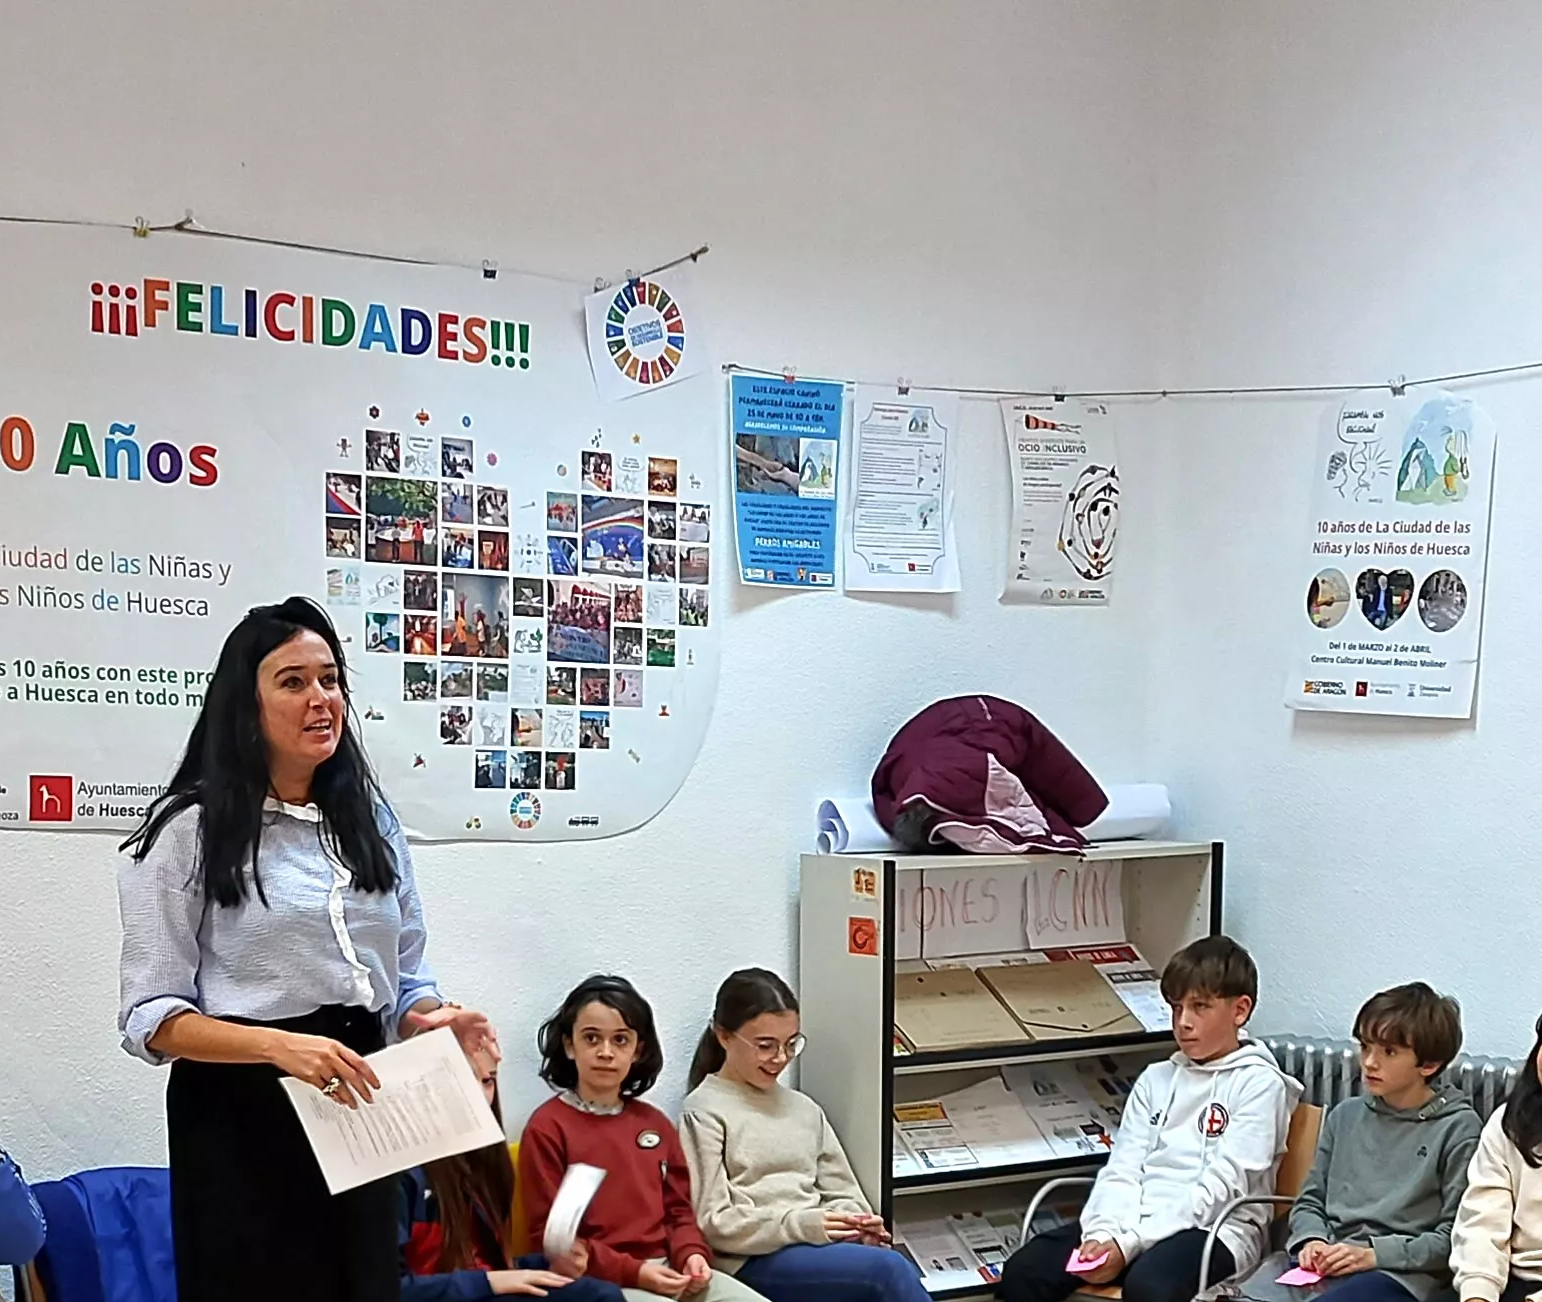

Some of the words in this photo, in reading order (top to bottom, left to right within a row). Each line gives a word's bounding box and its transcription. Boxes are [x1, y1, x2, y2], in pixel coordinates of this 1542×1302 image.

[90, 278, 531, 369] ¡¡¡FELICIDADES!!!
[54, 420, 219, 487] Años
[1018, 443, 1041, 453] OCIO
[1043, 444, 1087, 454] NCLUSIVO
[1317, 521, 1329, 534] 10
[1330, 520, 1356, 534] años
[1358, 521, 1373, 534] de
[1376, 521, 1390, 534] La
[1392, 520, 1433, 534] Ciudad
[1435, 520, 1451, 534] de
[1453, 520, 1471, 534] las
[1312, 542, 1342, 555] Niñas
[1344, 545, 1353, 558] y
[1354, 542, 1370, 555] los
[1373, 541, 1407, 555] Niños
[1410, 541, 1423, 556] de
[1426, 541, 1471, 556] Huesca
[75, 549, 104, 573] de
[110, 551, 142, 575] las
[148, 554, 213, 580] Niñas
[217, 562, 233, 586] y
[17, 584, 85, 611] Niños
[91, 587, 120, 611] de
[126, 591, 210, 617] Huesca
[1328, 642, 1341, 651] Del
[1347, 643, 1357, 651] de
[1358, 643, 1384, 652] MARZO
[1385, 644, 1393, 652] al
[1399, 645, 1409, 654] de
[1311, 654, 1334, 665] Centro
[1335, 656, 1364, 666] Cultural
[1365, 657, 1392, 667] Manuel
[1393, 658, 1418, 668] Benito
[12, 659, 36, 678] 10
[42, 658, 91, 680] años
[95, 664, 132, 682] con
[137, 665, 178, 685] este
[6, 686, 19, 701] a
[25, 683, 99, 704] Huesca
[105, 690, 129, 705] en
[135, 687, 180, 706] todo
[77, 804, 95, 817] de
